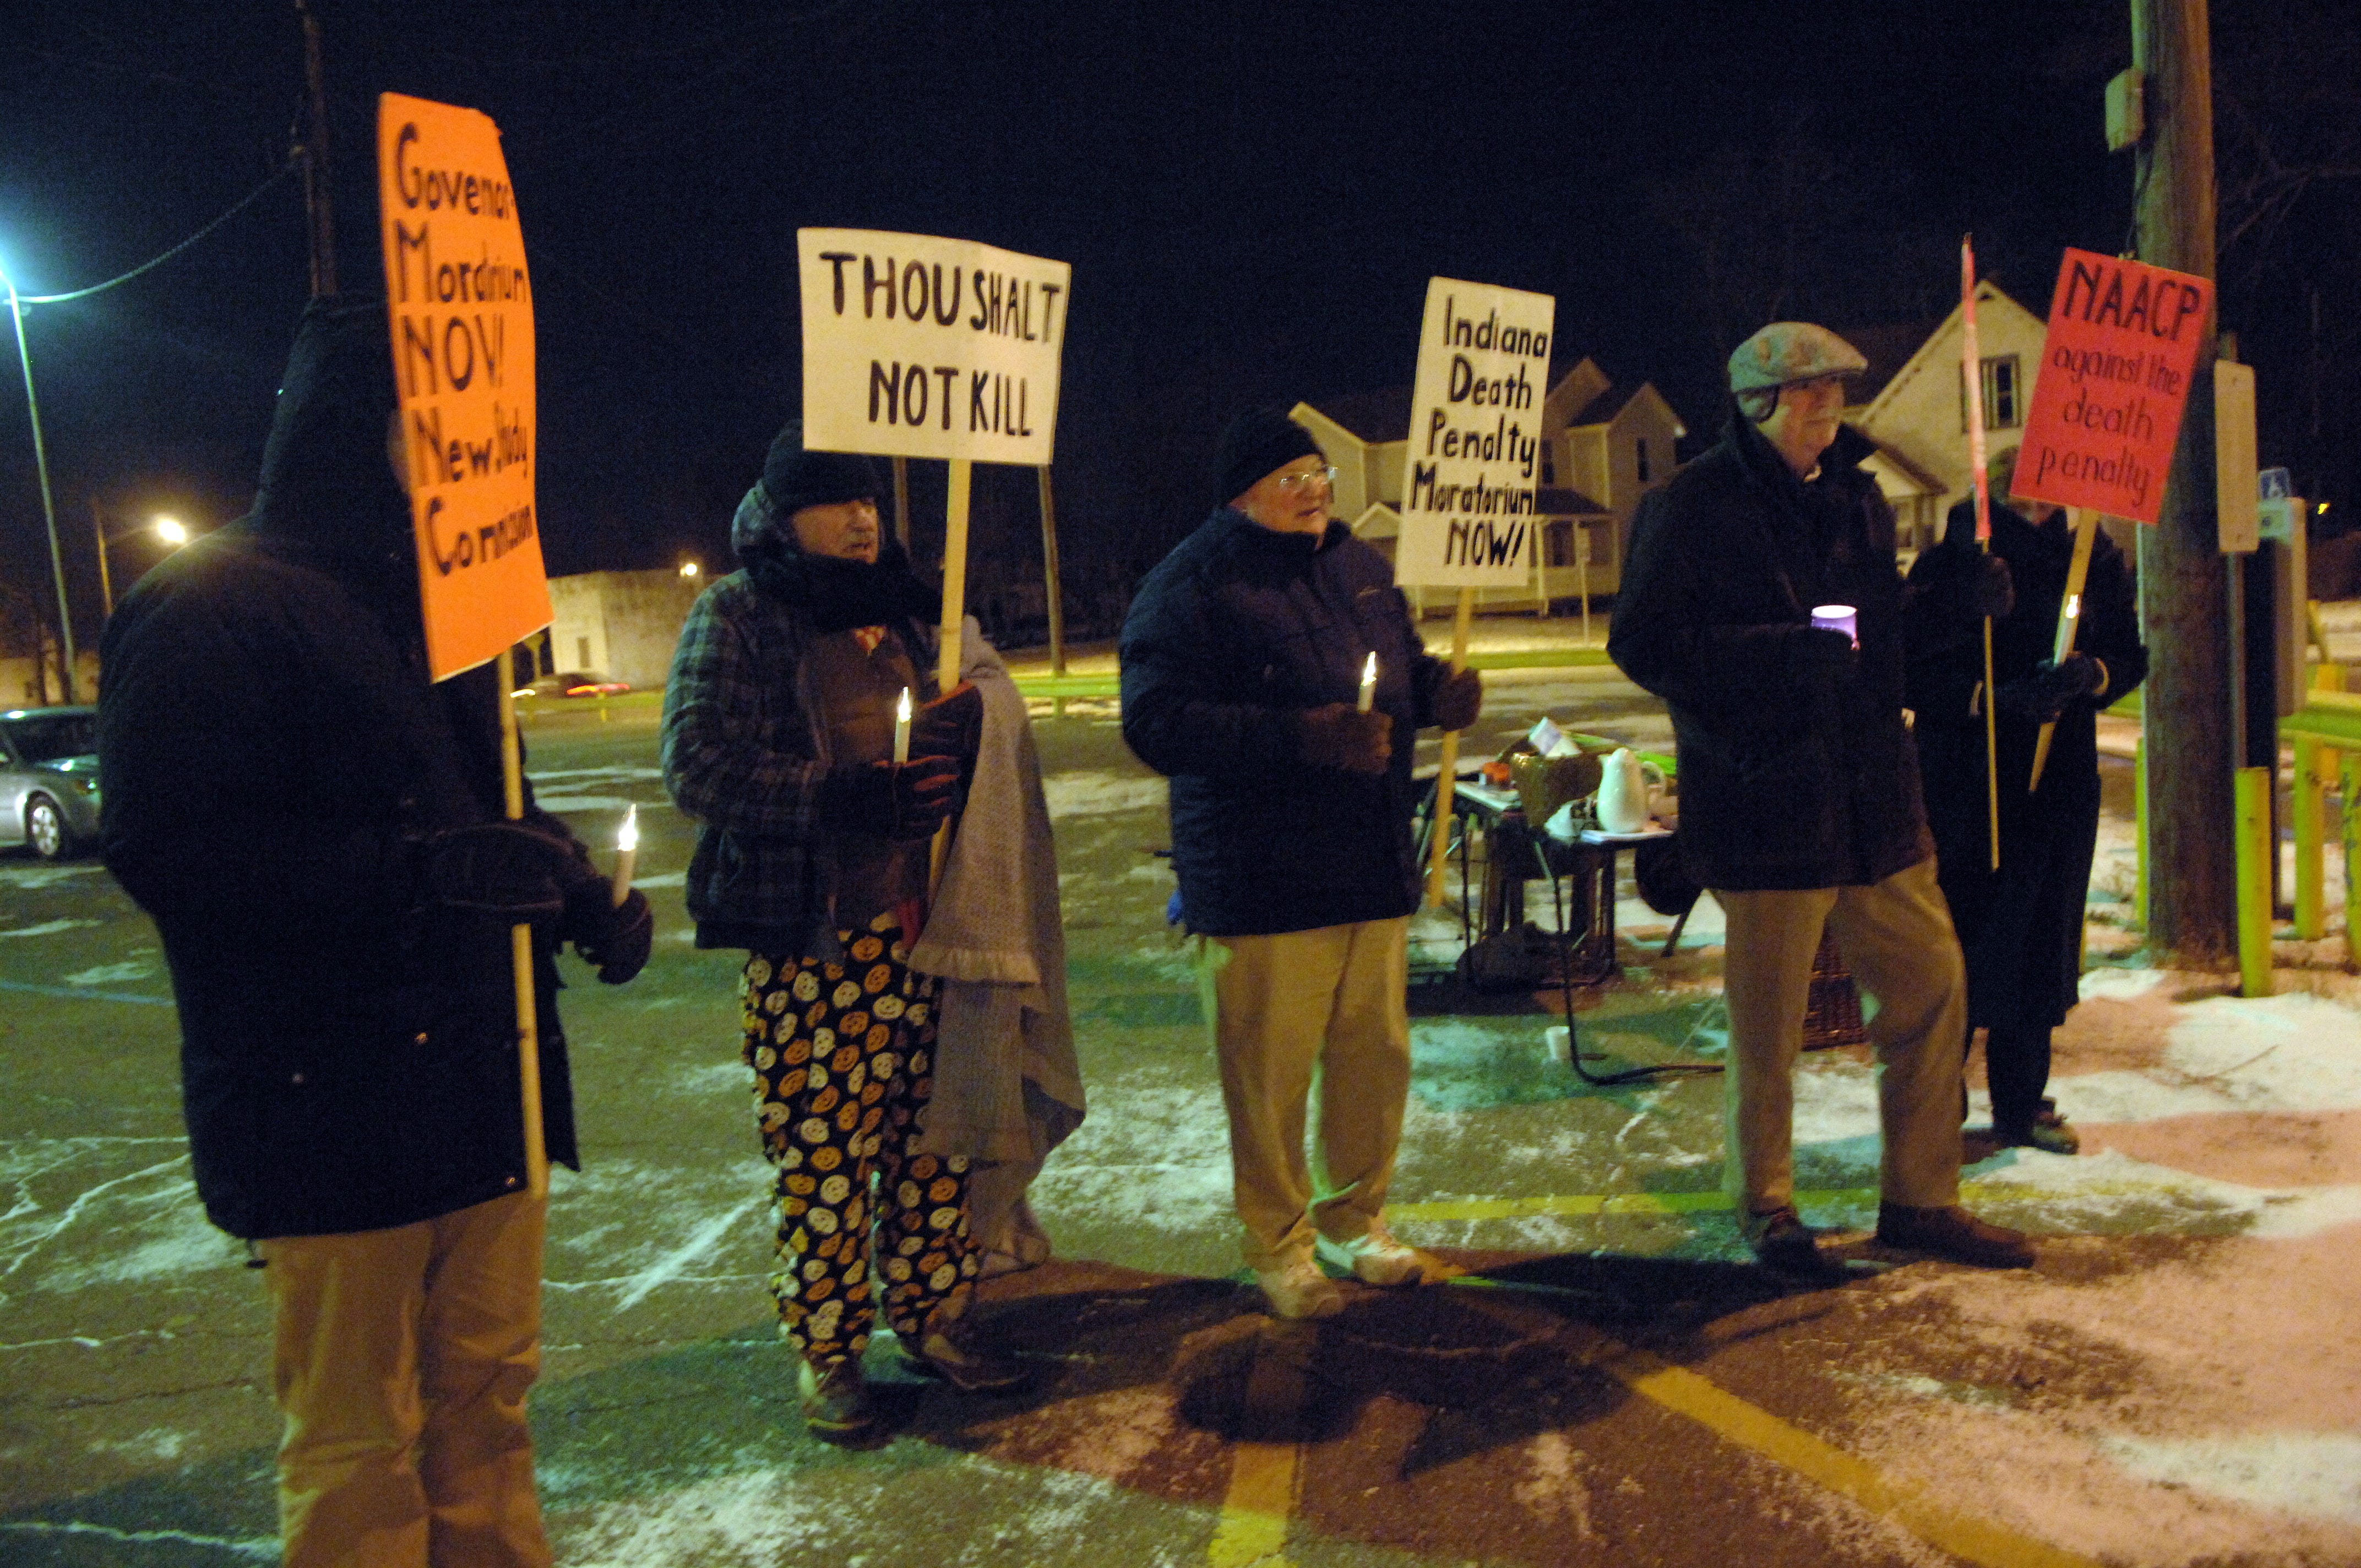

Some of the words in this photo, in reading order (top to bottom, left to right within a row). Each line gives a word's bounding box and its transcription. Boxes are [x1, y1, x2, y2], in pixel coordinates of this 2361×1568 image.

[819, 252, 961, 326] THOU
[970, 269, 1063, 343] SHALT
[1443, 294, 1548, 358] Indiana
[2063, 259, 2201, 341] NAACP
[868, 359, 959, 431] NOT
[970, 369, 1032, 436] KILL
[1448, 353, 1532, 410] Death
[2053, 344, 2144, 384] against
[2147, 350, 2182, 396] the
[1426, 407, 1537, 478] Penalty
[2063, 386, 2153, 440] death
[412, 406, 494, 487] New
[2036, 445, 2151, 508] penalty
[1408, 459, 1534, 516] Moratorium
[1444, 518, 1525, 568] NOW!
